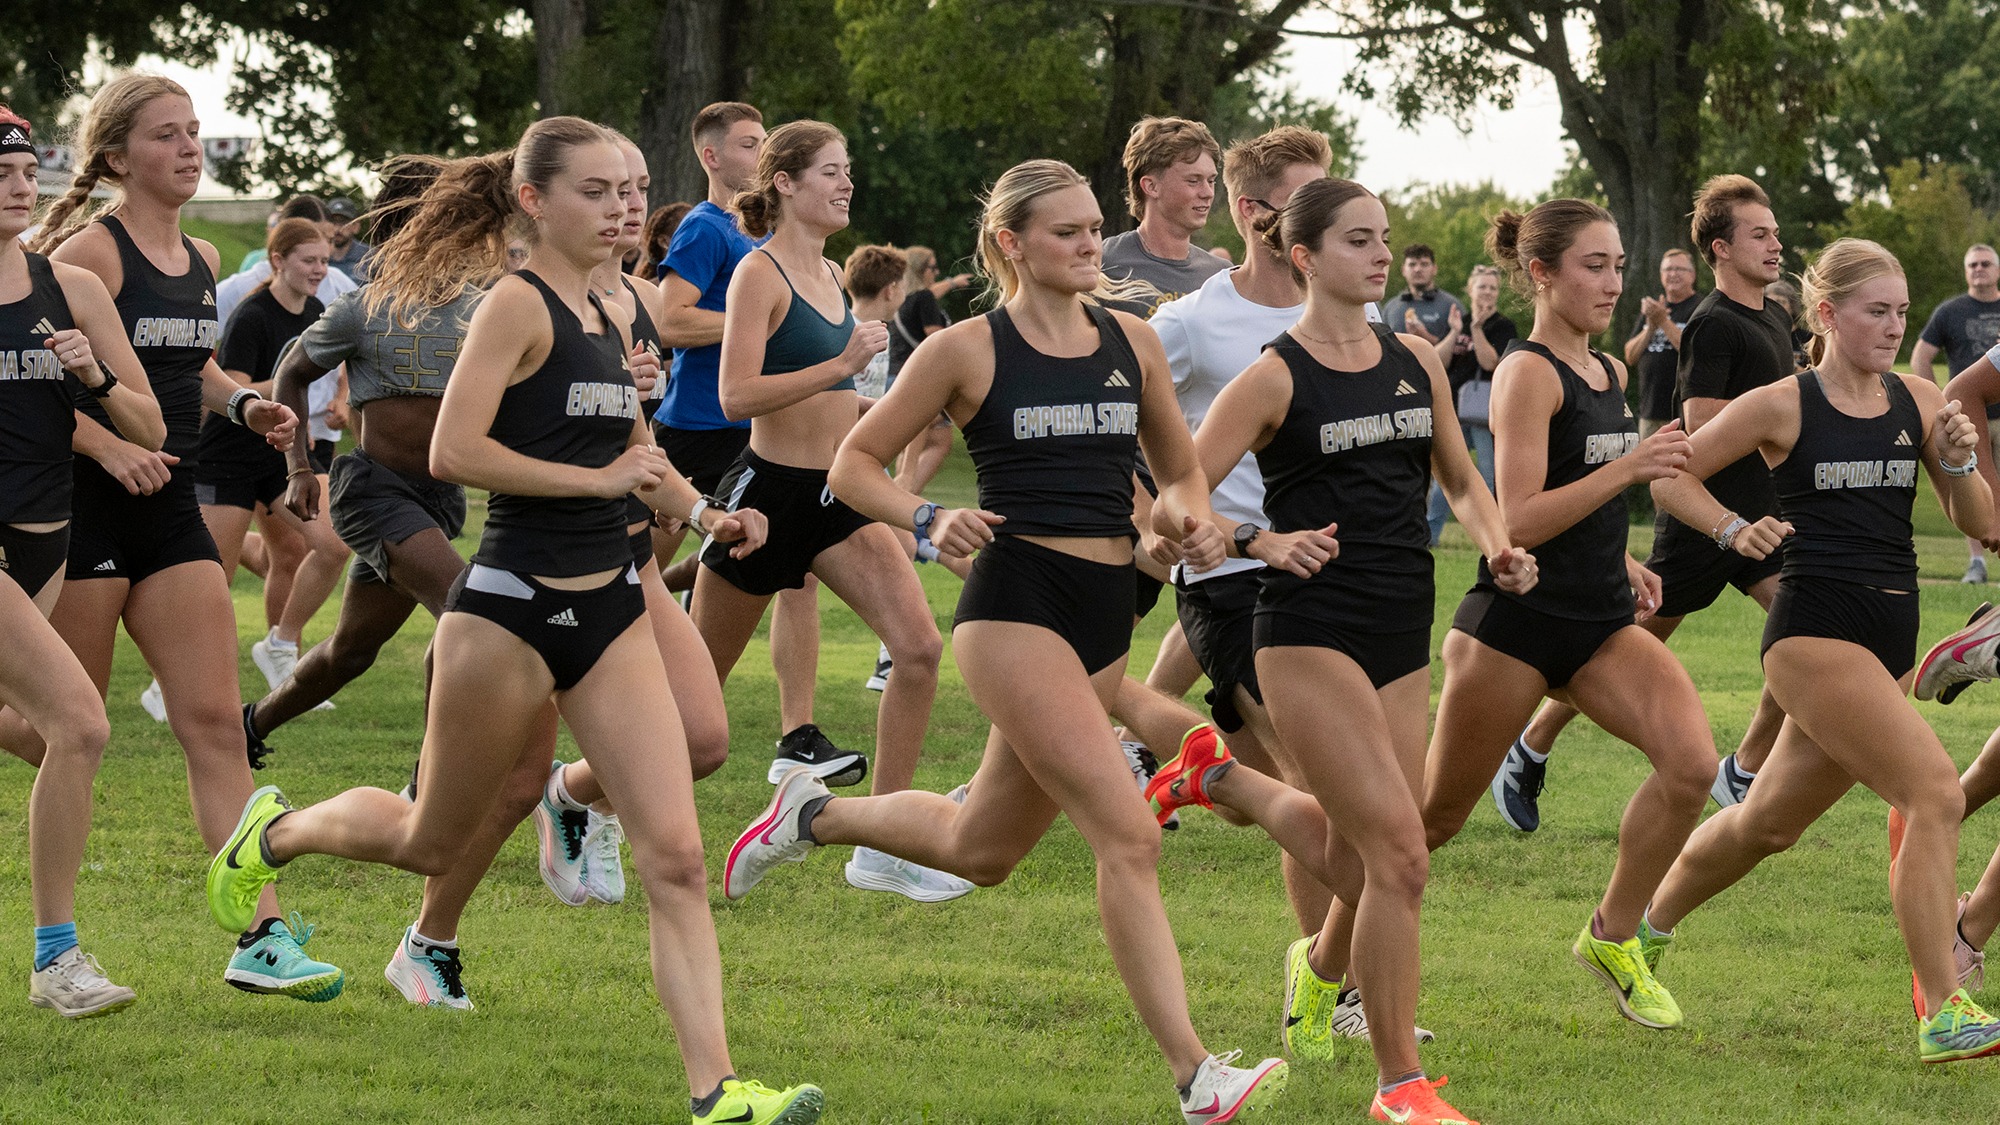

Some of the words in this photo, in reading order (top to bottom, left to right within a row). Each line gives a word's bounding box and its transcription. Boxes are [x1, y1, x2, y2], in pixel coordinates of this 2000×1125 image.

[2, 137, 31, 146] adidas
[133, 317, 196, 347] EMPORIA
[566, 382, 623, 417] EMPORIA
[1014, 403, 1096, 440] EMPORIA
[1097, 402, 1138, 435] STATE
[1320, 413, 1395, 454] EMPORIA
[1394, 407, 1433, 440] STATE
[1815, 460, 1884, 490] EMPORIA
[1882, 460, 1916, 487] STATE
[547, 617, 579, 627] adidas
